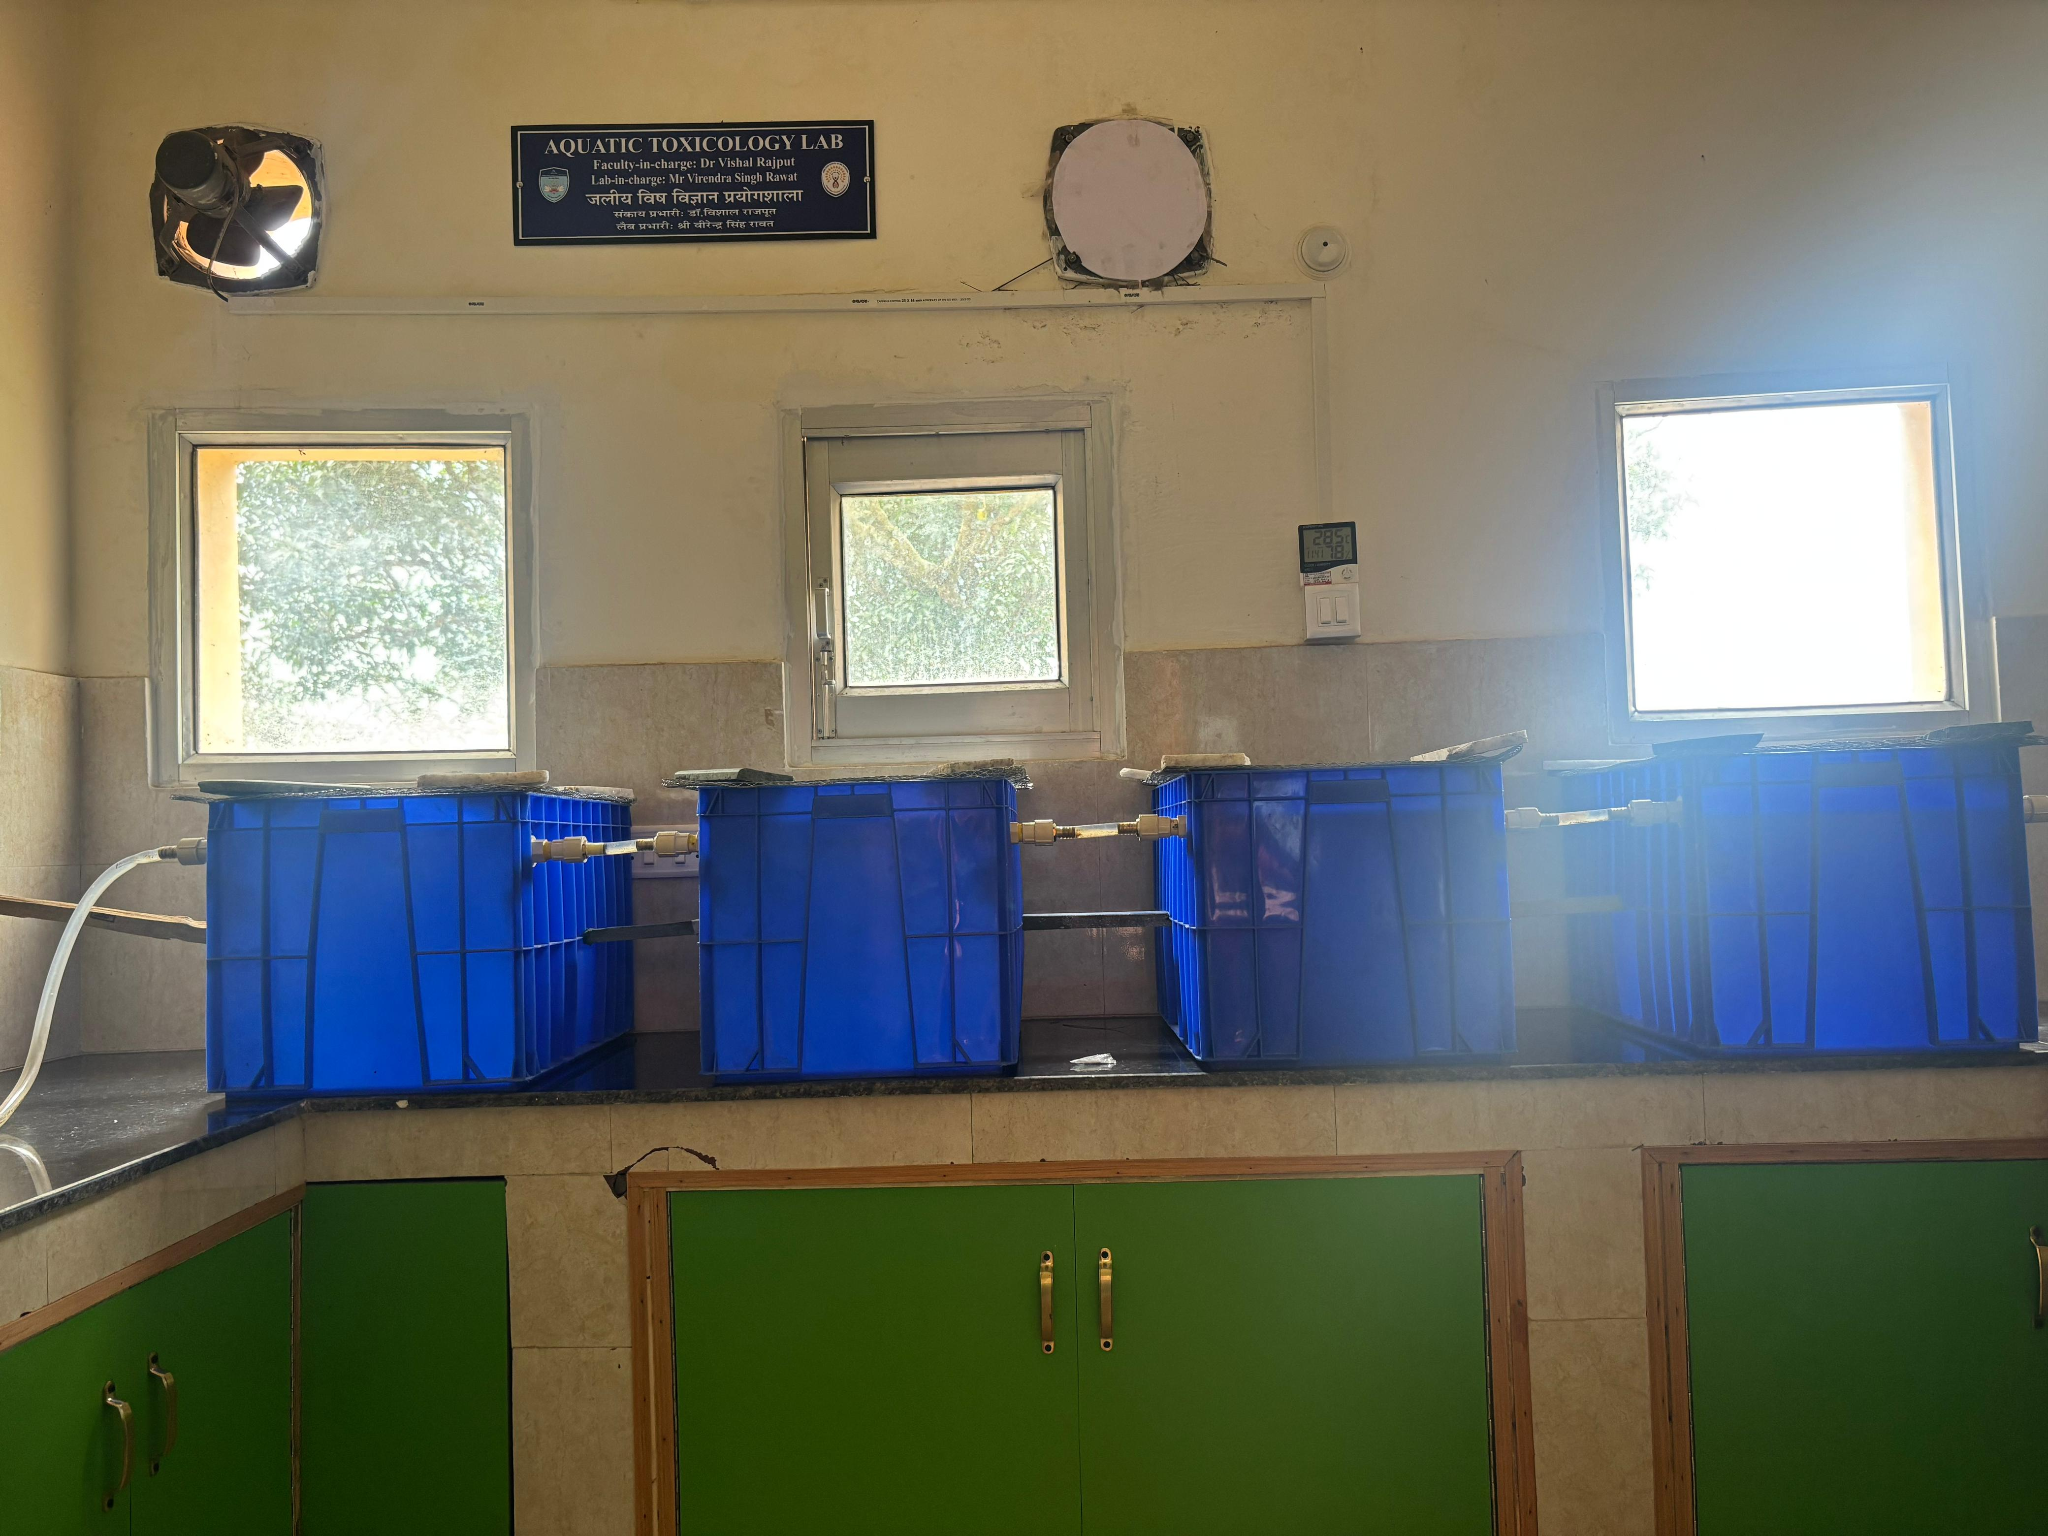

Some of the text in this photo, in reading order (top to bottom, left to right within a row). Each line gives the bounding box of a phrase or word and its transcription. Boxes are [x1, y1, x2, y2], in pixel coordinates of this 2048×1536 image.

[544, 133, 844, 158] AQUATIC TOXICOLOGY LAB
[593, 156, 796, 172] Faculty-in-charge: Dr Vishal Rajput
[591, 171, 798, 187] Lab-in-charge: Mr Virendra Singh Rawat
[585, 186, 804, 206] जलीय विष विज्ञान प्रयोगशाला
[613, 209, 646, 219] संकाय
[648, 208, 684, 218] प्रभारी:
[742, 208, 777, 218] राजपूत
[638, 220, 674, 231] प्रभारी:
[677, 220, 691, 230] श्री
[726, 219, 747, 229] सिंह
[749, 220, 775, 229] रावत
